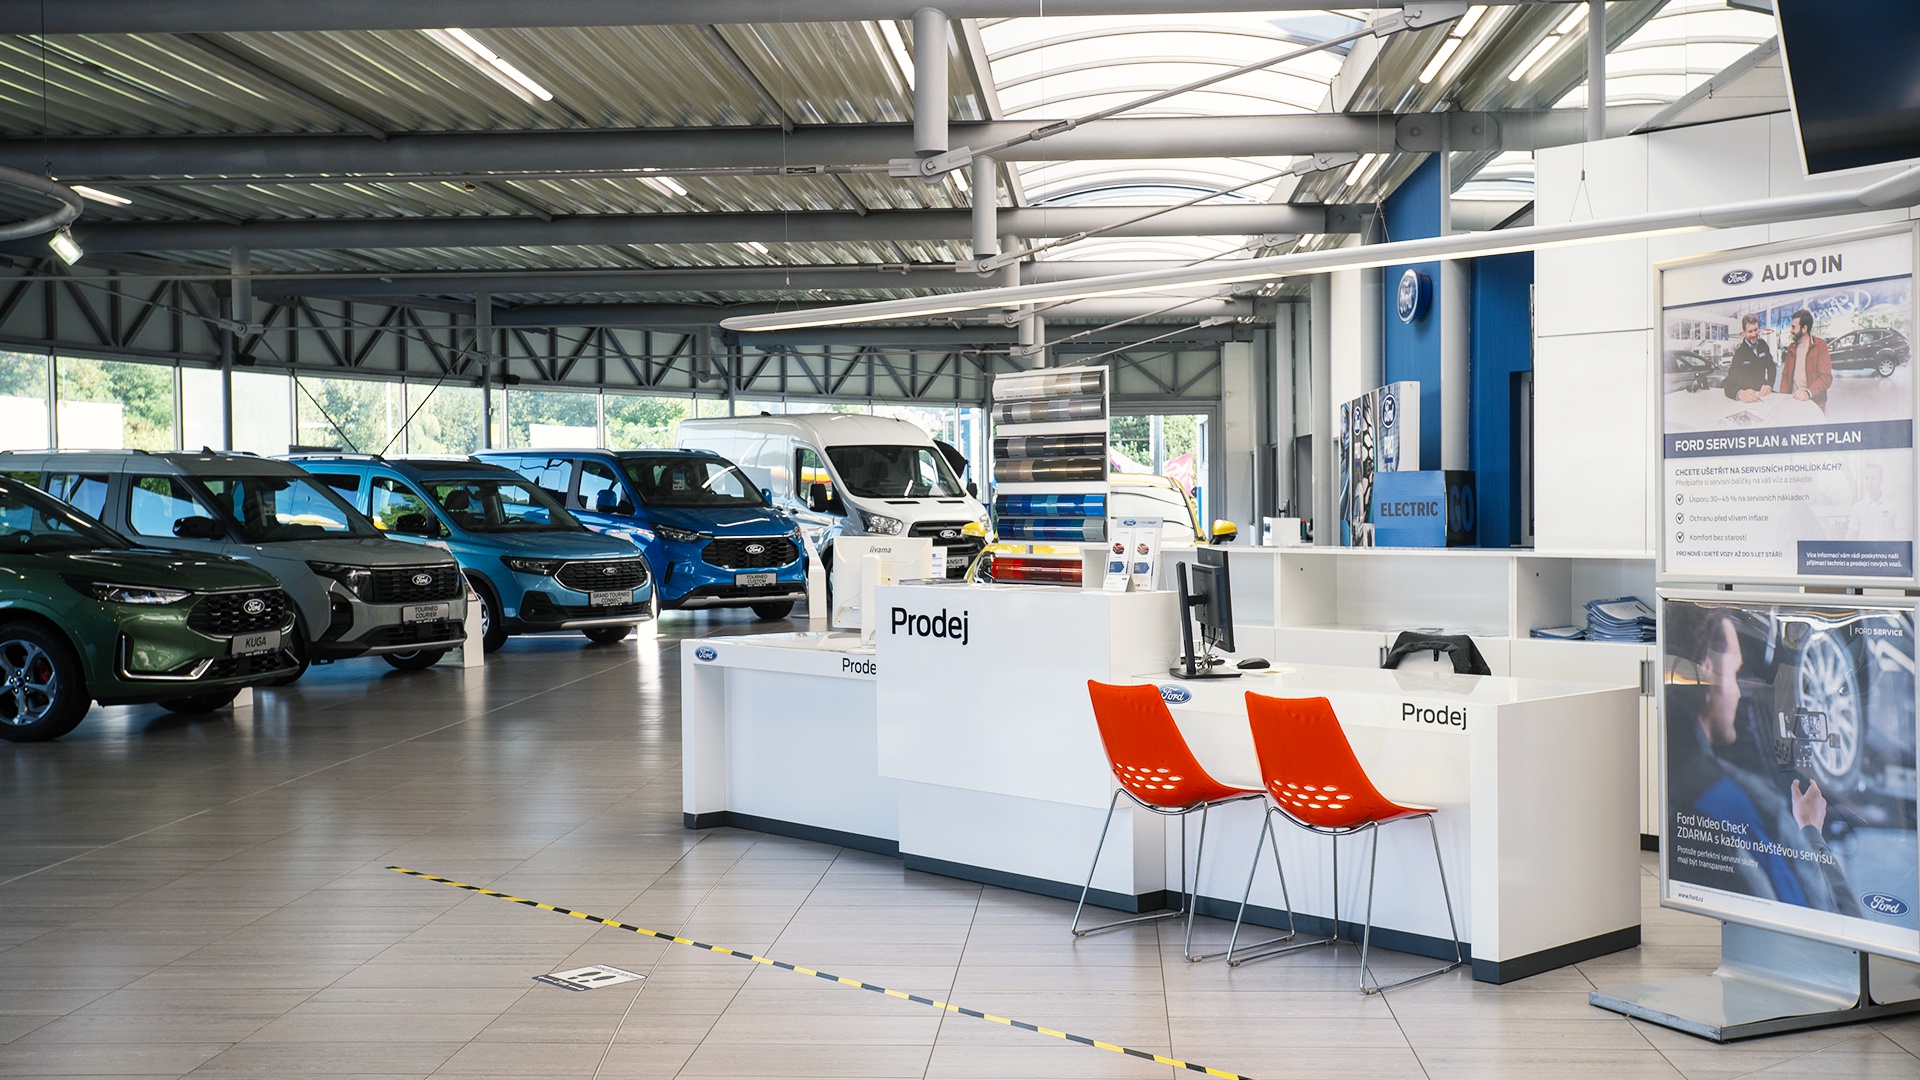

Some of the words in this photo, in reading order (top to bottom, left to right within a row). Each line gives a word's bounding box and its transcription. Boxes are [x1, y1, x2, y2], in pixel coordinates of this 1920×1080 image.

[1761, 258, 1817, 282] AUTO
[1822, 254, 1842, 274] IN
[1675, 439, 1705, 452] FORD
[1706, 437, 1747, 450] SERVIS
[1748, 435, 1779, 448] PLAN
[1781, 437, 1789, 446] &
[1790, 432, 1824, 446] NEXT
[1826, 430, 1861, 444] PLAN
[1675, 468, 1700, 476] CHCETE
[1701, 466, 1729, 475] UŠETŘIT
[1741, 464, 1783, 474] SERVISNÍCH
[1784, 462, 1842, 472] PROHLÍDKÁCH?
[1380, 501, 1438, 517] ELECTRIC
[1449, 484, 1474, 533] GO
[869, 545, 892, 554] iiyama
[414, 605, 438, 613] TOURNEO
[891, 606, 969, 646] Prodej
[1854, 627, 1872, 635] FORD
[1873, 628, 1903, 637] SERVICE
[245, 636, 267, 648] KUGA
[842, 657, 876, 675] Prode
[1402, 702, 1467, 731] Prodej
[1677, 812, 1695, 826] Ford
[1696, 815, 1720, 831] Video
[1677, 826, 1713, 844] ZDARMA
[1714, 835, 1720, 845] s
[1721, 833, 1751, 850] každou
[1753, 840, 1798, 859] návštěvou
[1800, 850, 1836, 865] servisu.
[1870, 895, 1900, 914] Ford
